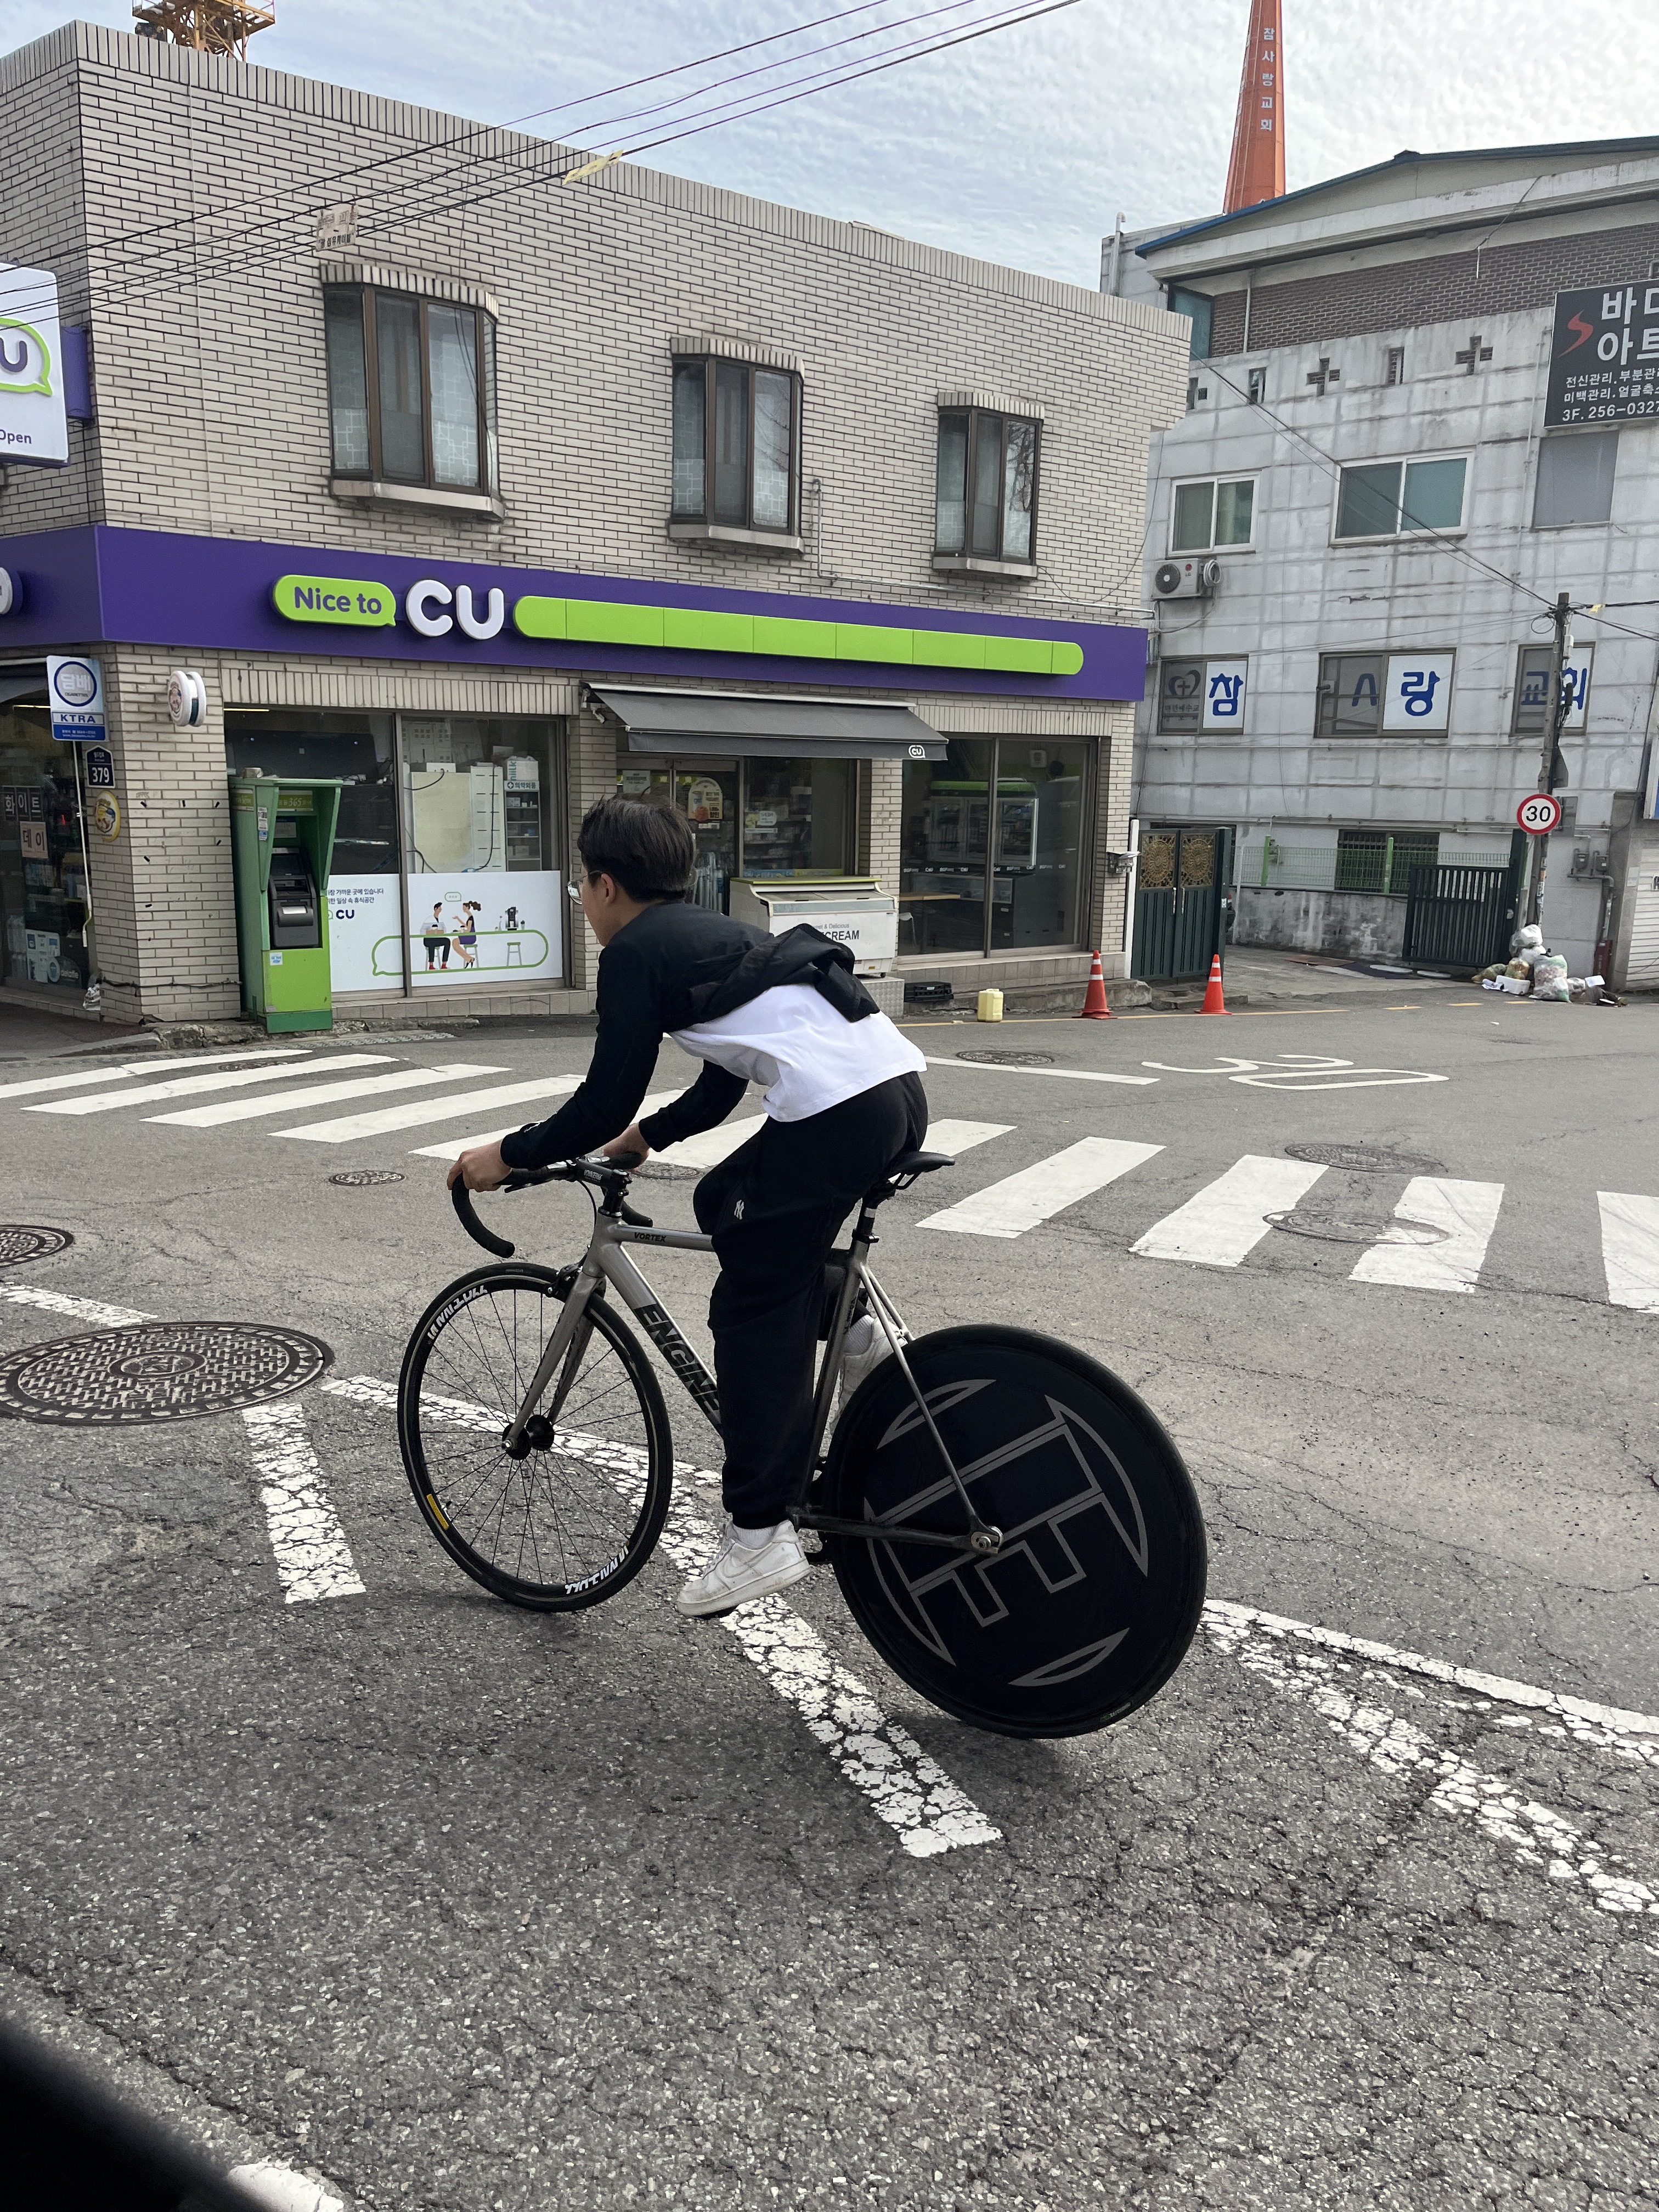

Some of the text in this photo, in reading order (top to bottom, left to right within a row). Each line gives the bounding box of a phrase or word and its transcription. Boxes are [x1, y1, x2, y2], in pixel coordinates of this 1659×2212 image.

[1260, 27, 1275, 132] 참사랑교회
[1619, 367, 1659, 382] 부분관
[294, 579, 505, 640] Nice to CU
[60, 673, 92, 691] 담배
[60, 714, 96, 723] KTRA
[92, 767, 110, 783] 379
[5, 792, 41, 814] 화이트
[1526, 806, 1551, 822] 30
[22, 828, 45, 851] 데이
[336, 909, 355, 919] CU
[634, 1232, 667, 1243] VORTEX
